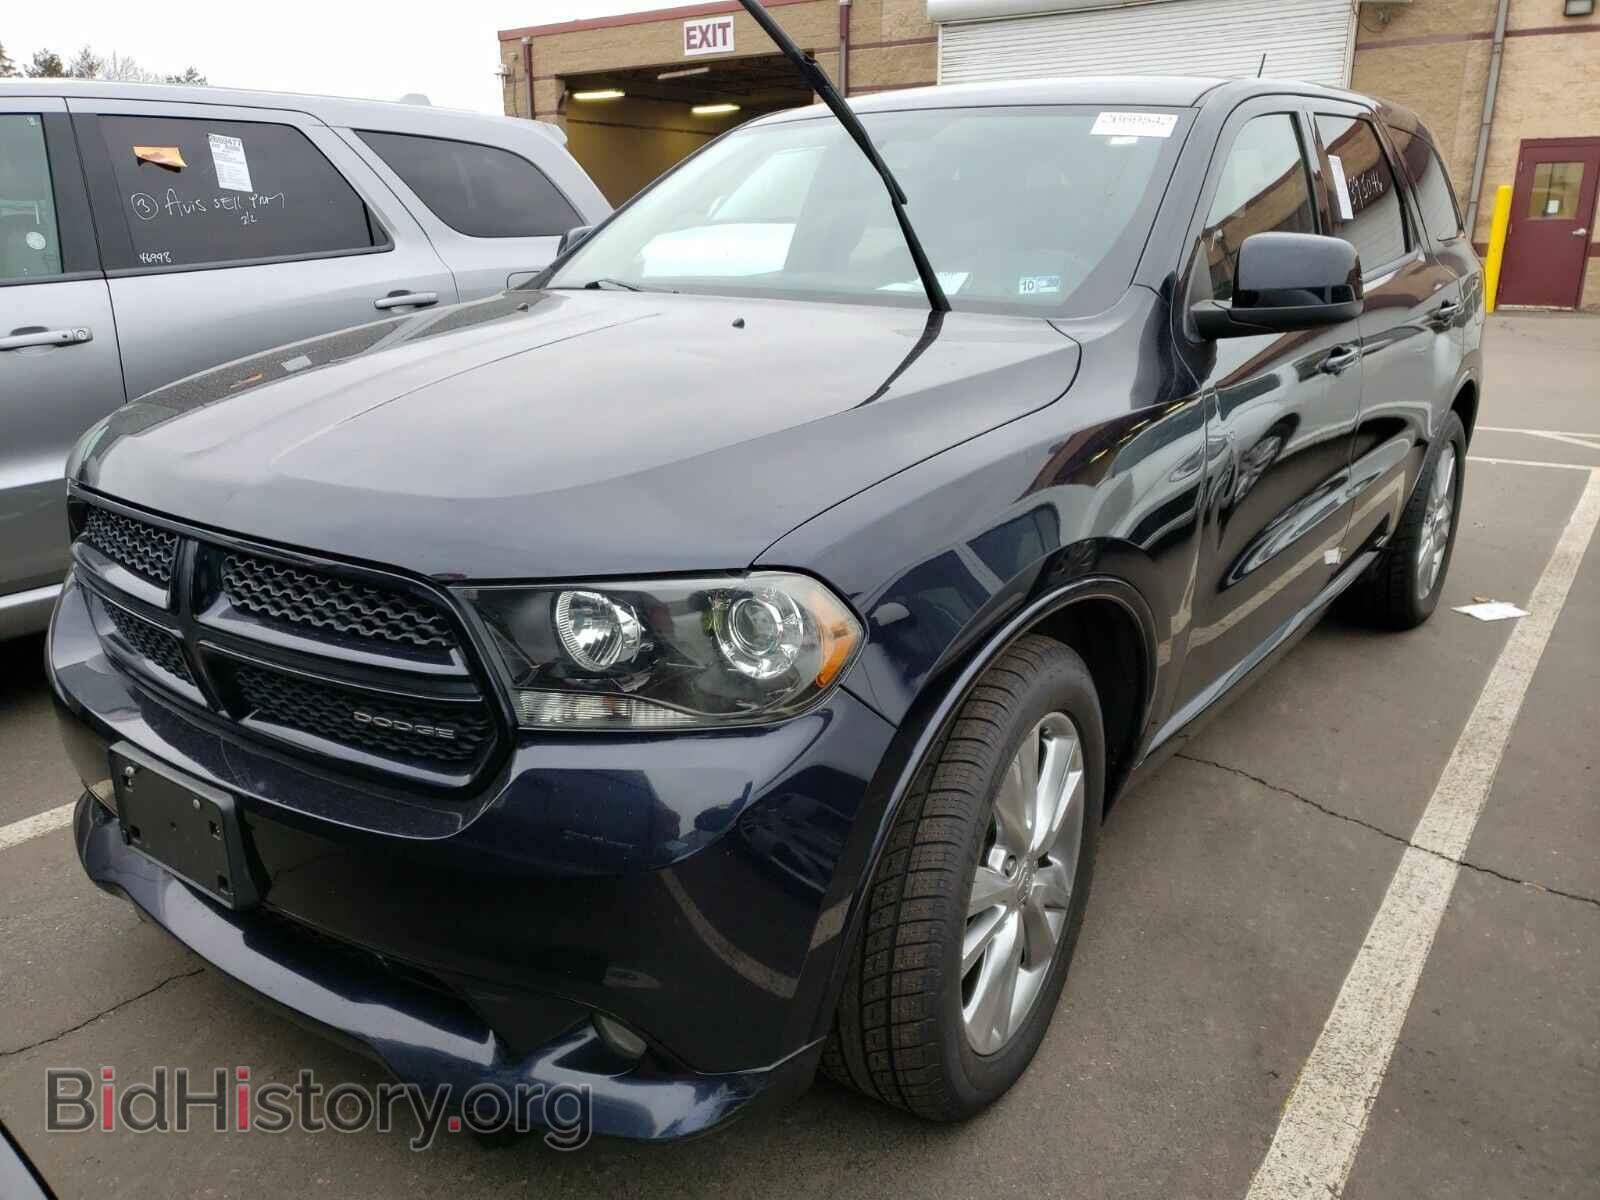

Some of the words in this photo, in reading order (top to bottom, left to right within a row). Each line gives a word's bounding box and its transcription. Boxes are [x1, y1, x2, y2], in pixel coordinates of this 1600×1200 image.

[686, 21, 732, 50] EXIT
[164, 188, 207, 217] Avis
[353, 711, 455, 739] DODGE
